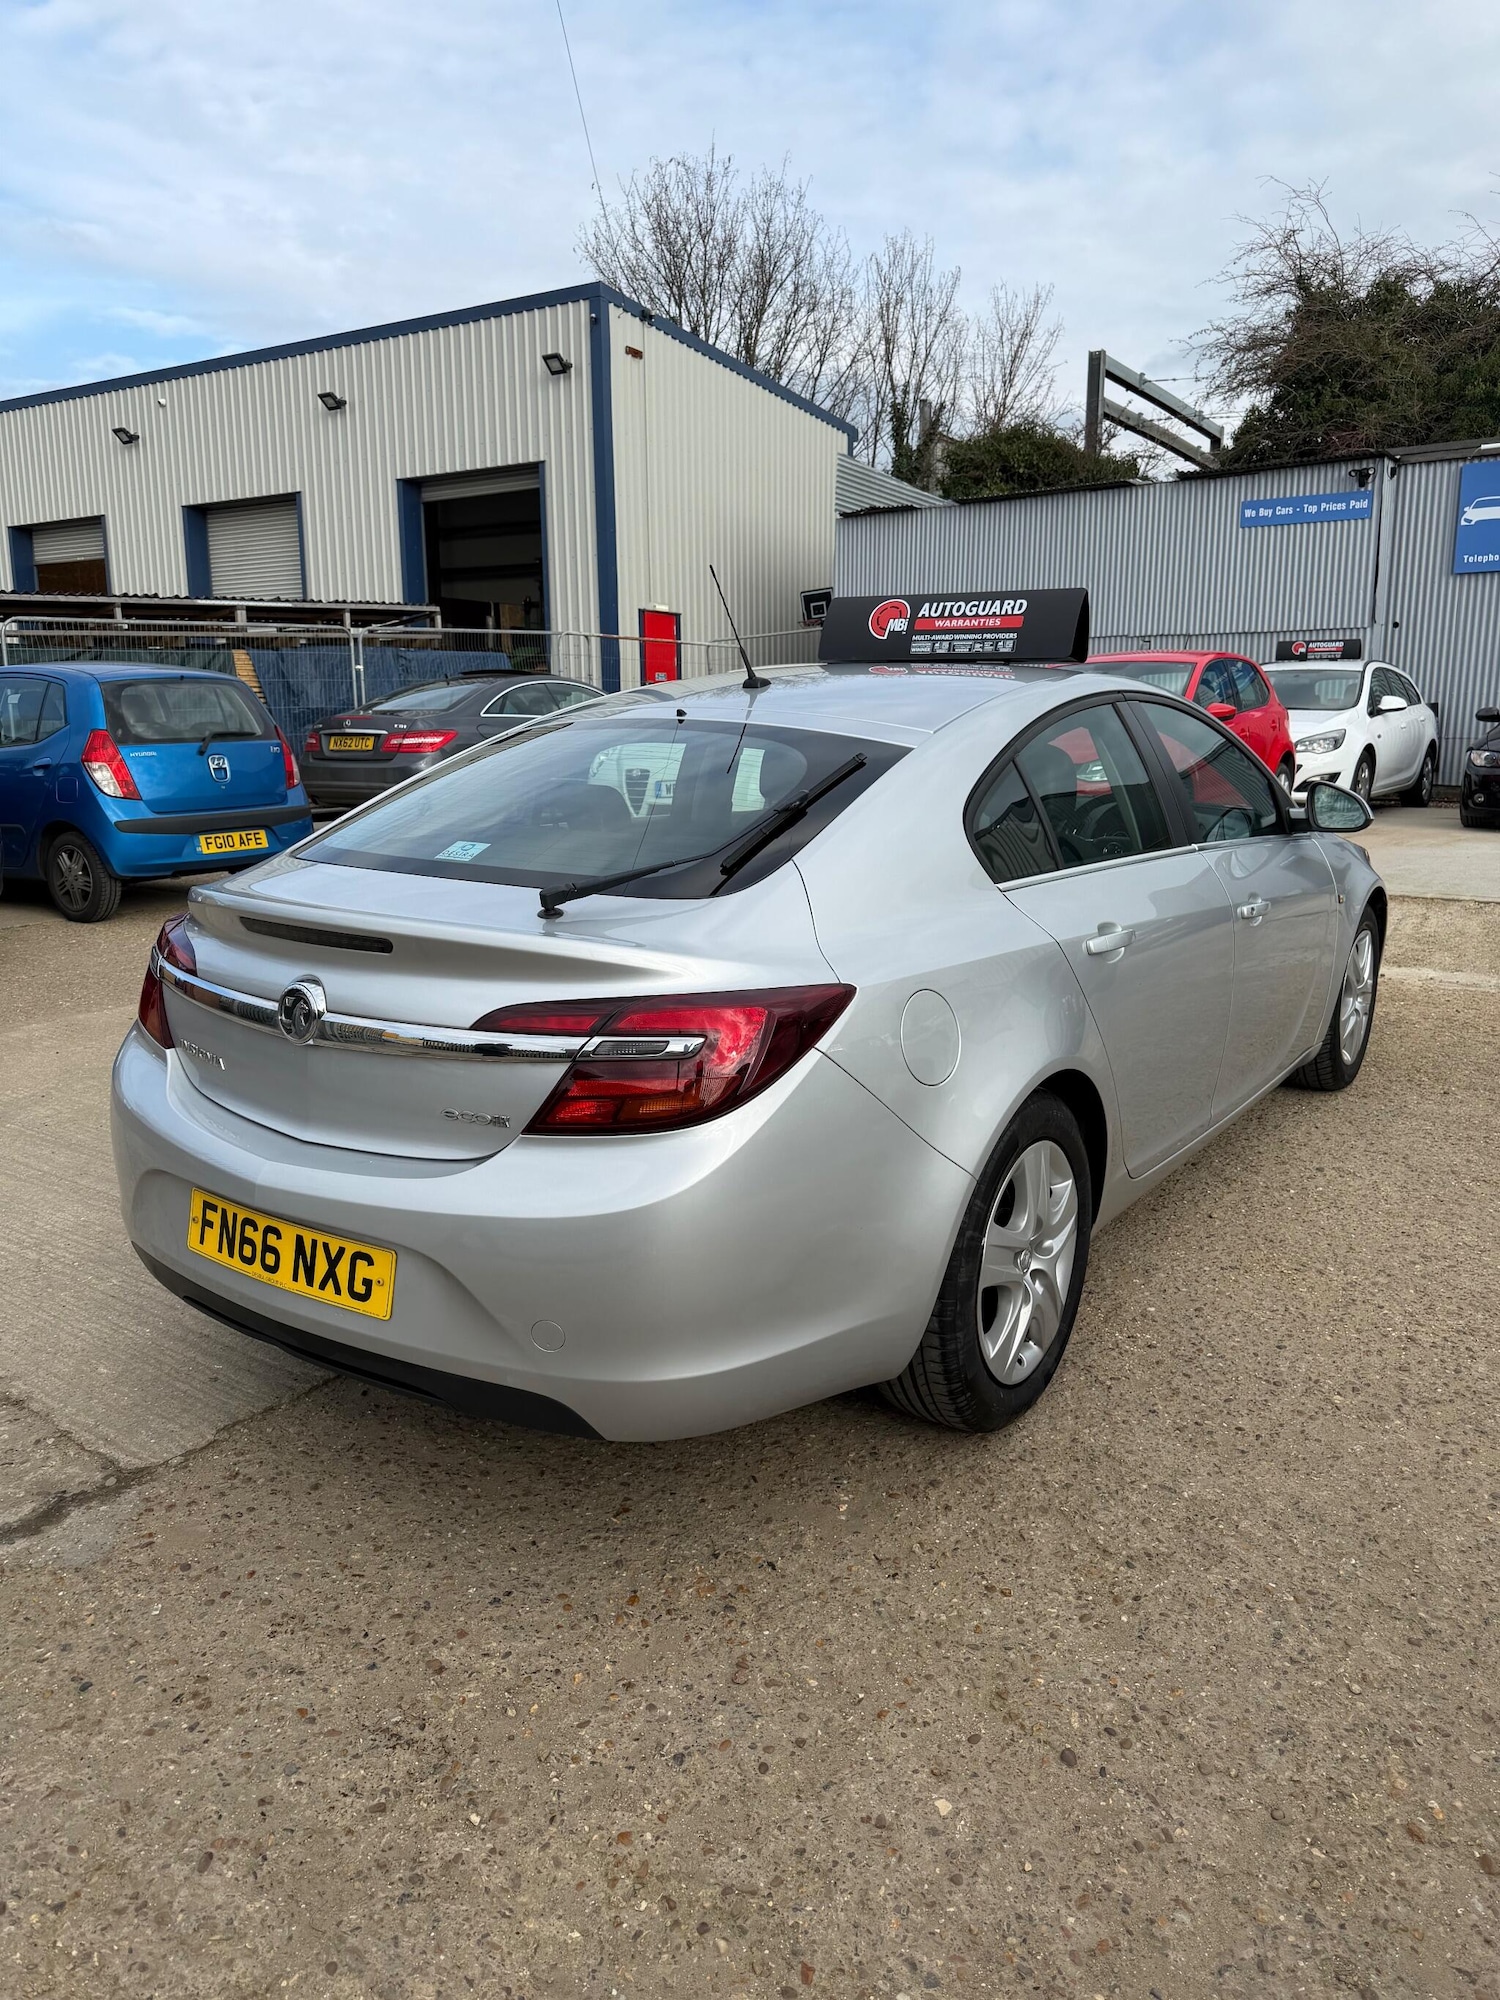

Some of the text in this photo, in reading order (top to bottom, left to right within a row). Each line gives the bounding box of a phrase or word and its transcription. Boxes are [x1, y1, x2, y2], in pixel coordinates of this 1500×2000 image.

[1244, 508, 1256, 518] We
[1259, 507, 1273, 518] Buy
[1276, 506, 1293, 516] Cars
[1304, 504, 1318, 514] Top
[1320, 501, 1346, 512] Prices
[1350, 499, 1368, 509] Paid
[918, 599, 1028, 618] AUTOGUARD
[934, 618, 1002, 628] WARRANTIES
[332, 736, 370, 748] NX62 UTC
[204, 832, 262, 850] FG10 AFE
[199, 1200, 375, 1303] FN66 NXG
